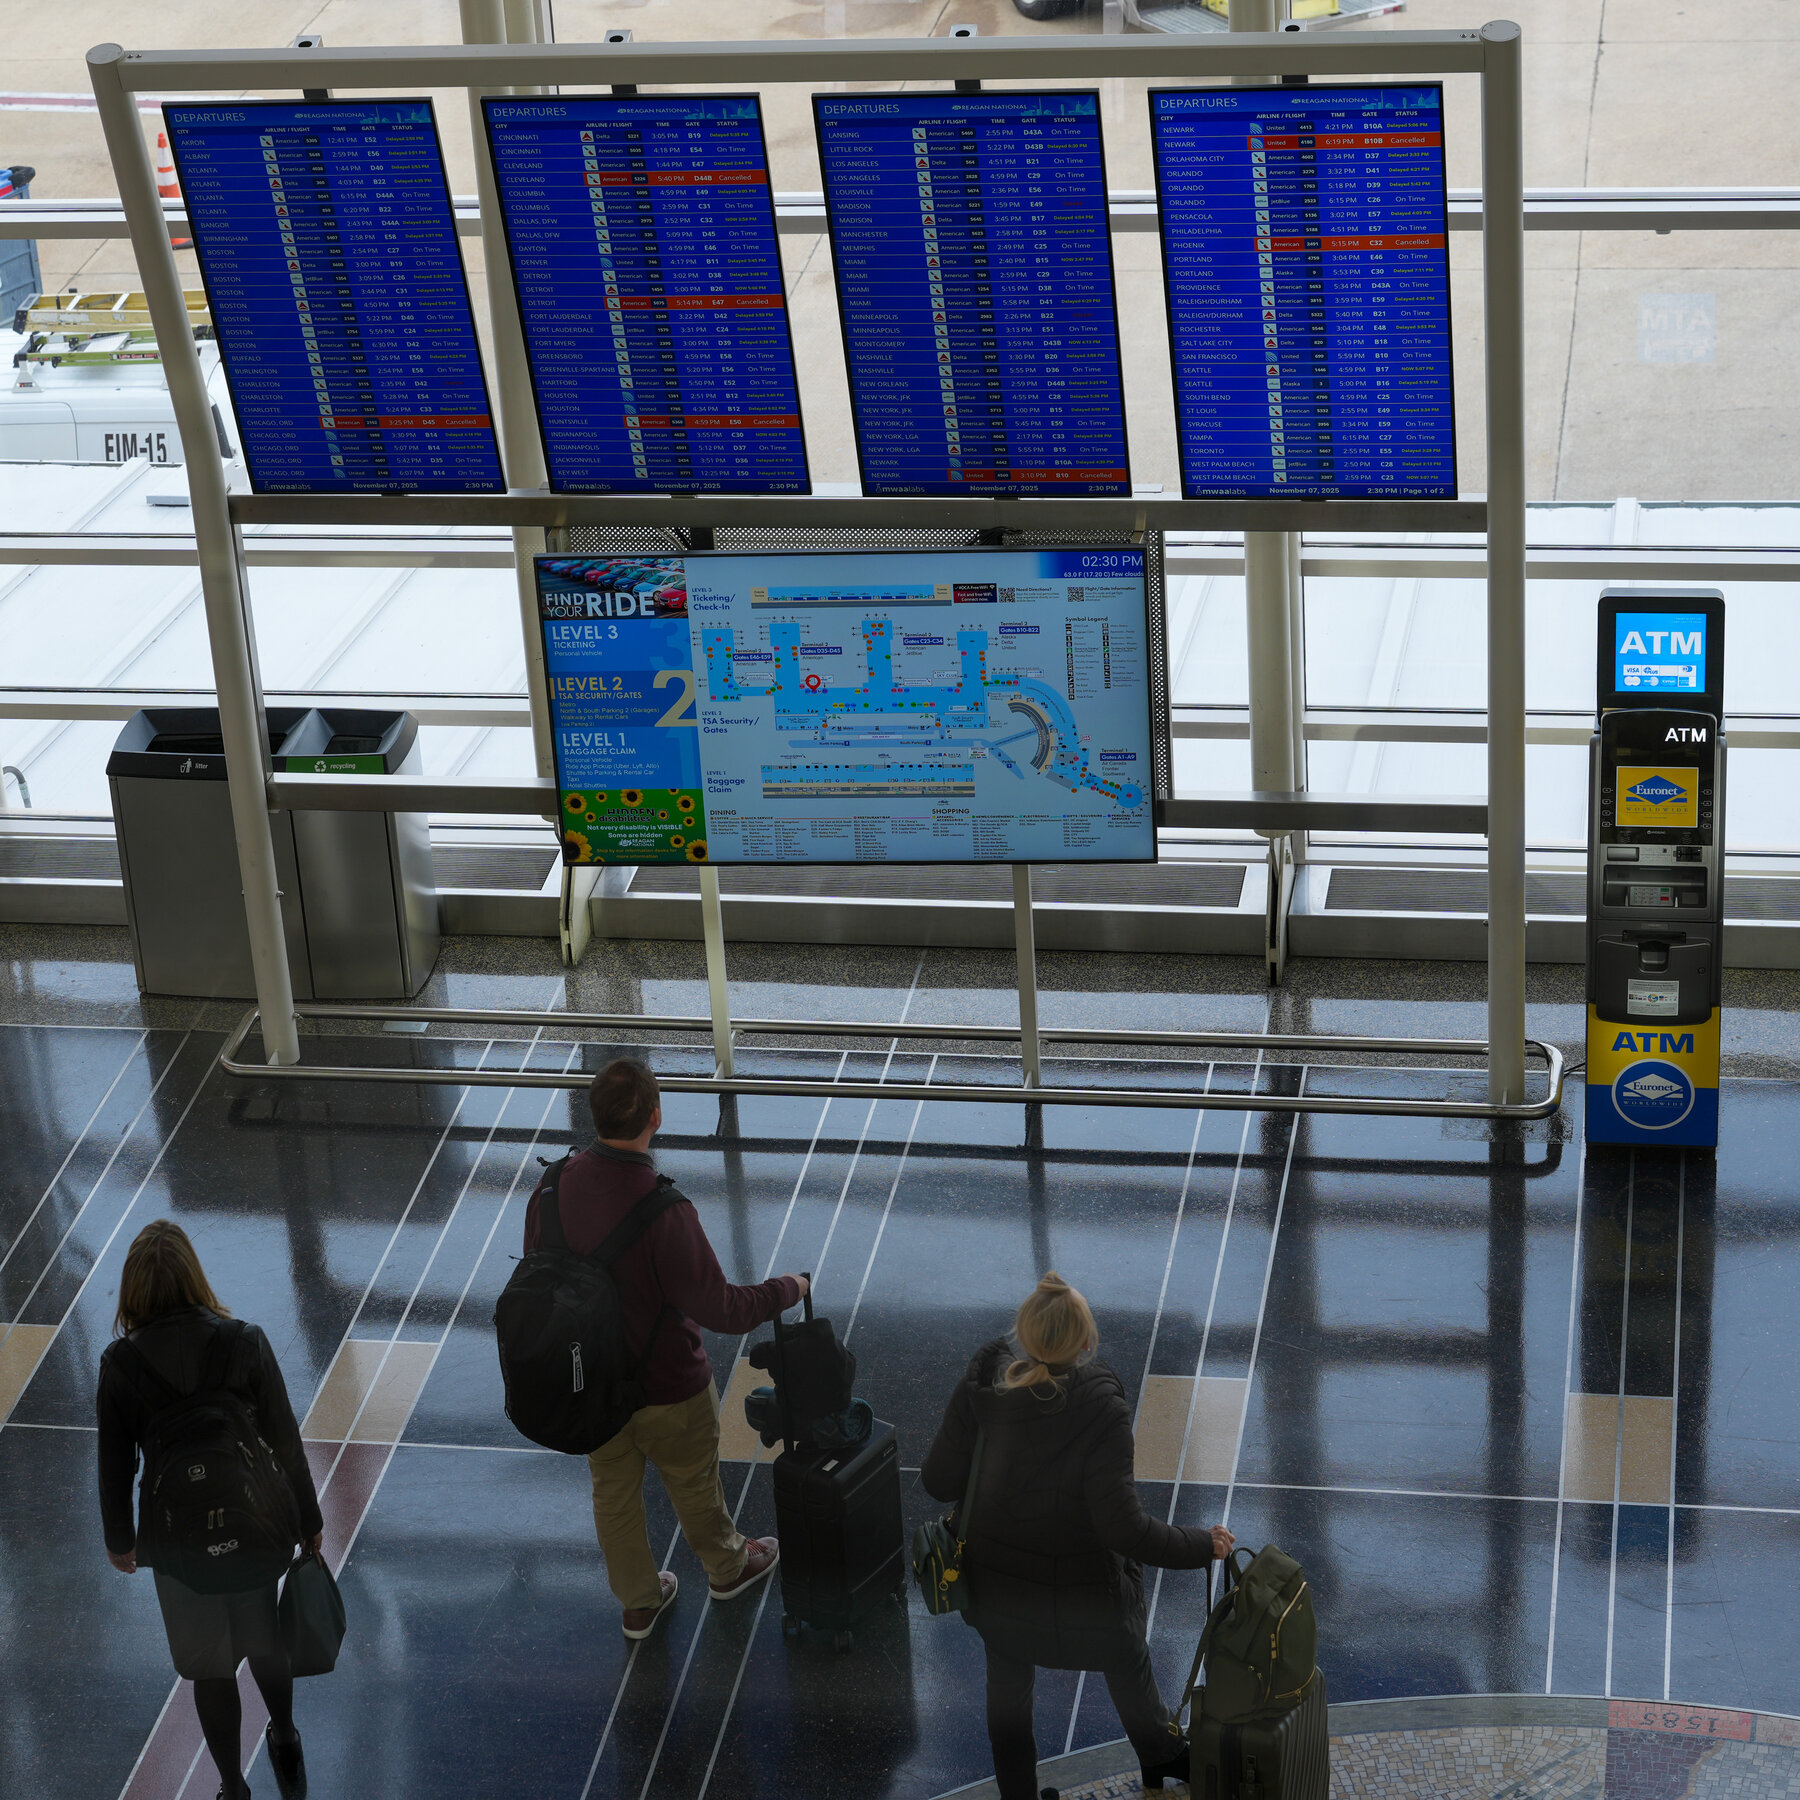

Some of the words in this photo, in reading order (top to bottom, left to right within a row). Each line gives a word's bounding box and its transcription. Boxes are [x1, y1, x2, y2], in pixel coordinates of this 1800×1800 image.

[824, 104, 900, 114] DEPARTURES
[1160, 98, 1238, 109] DEPARTURES
[494, 107, 567, 117] DEPARTURES
[174, 113, 246, 123] DEPARTURES
[1082, 556, 1118, 567] 02:30
[1122, 556, 1143, 566] PM
[545, 593, 584, 605] FIND
[586, 592, 655, 616] RIDE
[692, 594, 736, 603] Ticketing/
[547, 606, 582, 617] YOUR
[693, 603, 730, 611] Check-In
[552, 626, 602, 640] LEVEL
[608, 625, 618, 639] 3
[1619, 631, 1702, 655] ATM
[558, 677, 608, 692] LEVEL
[613, 676, 623, 690] 2
[720, 717, 760, 726] Security/
[562, 733, 612, 747] LEVEL
[619, 733, 625, 745] 1
[1665, 728, 1706, 742] ATM
[330, 762, 356, 770] recycling
[707, 778, 745, 786] Baggage
[1636, 784, 1678, 796] Euronet
[1611, 1032, 1694, 1053] ATM
[1633, 1082, 1673, 1092] Euronet
[1638, 1712, 1718, 1734] 1585
